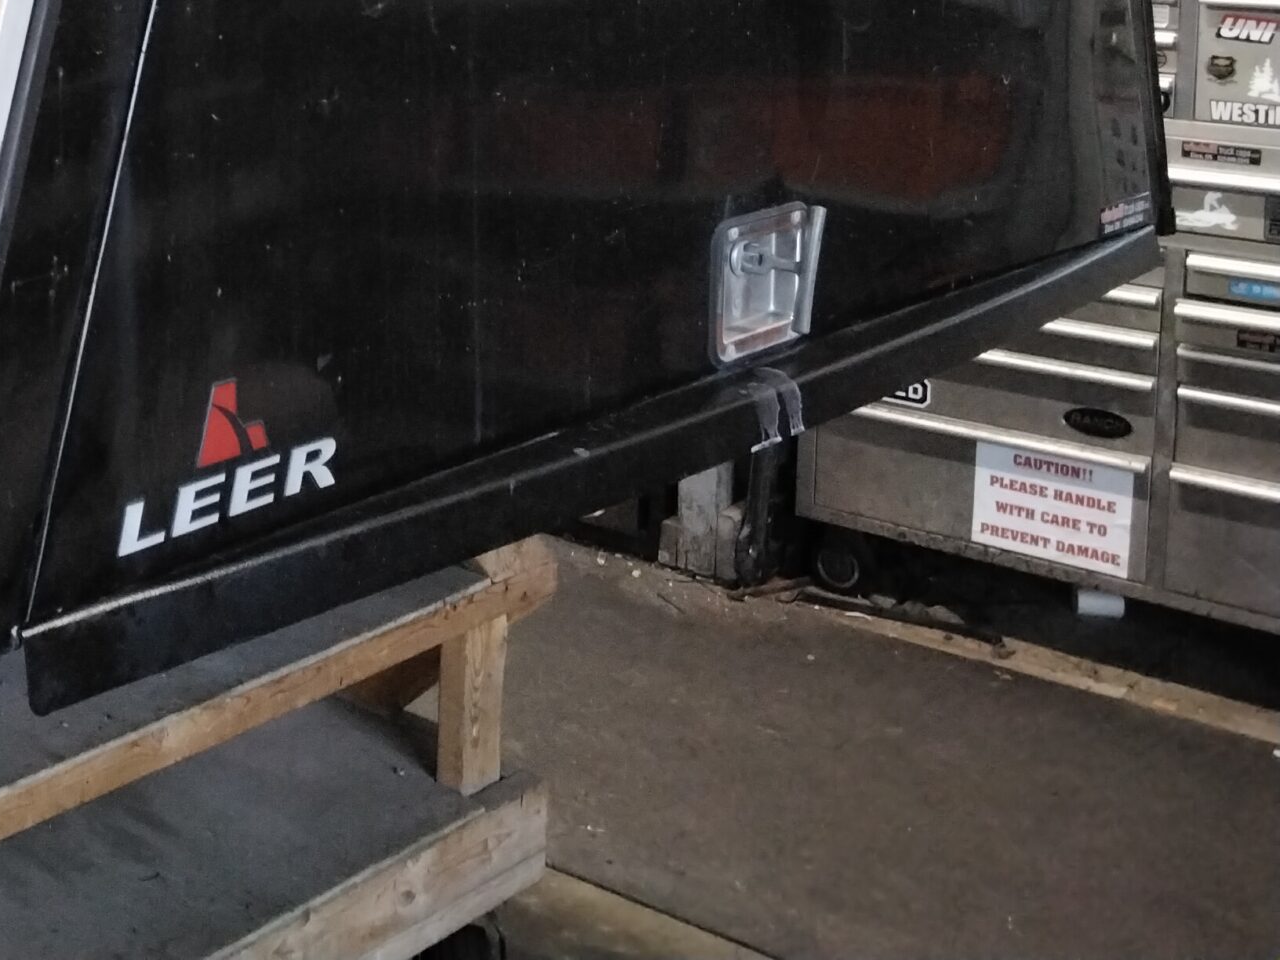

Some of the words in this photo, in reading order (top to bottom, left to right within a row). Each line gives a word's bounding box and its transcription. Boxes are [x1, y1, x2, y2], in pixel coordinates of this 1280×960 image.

[1219, 16, 1278, 43] UNI
[1210, 100, 1280, 126] WESTi
[1013, 453, 1093, 482] CAUTION!!
[118, 437, 336, 558] LEER
[989, 474, 1049, 499] PLEASE
[1053, 488, 1117, 514] HANDLE
[995, 501, 1035, 521] WITH
[1040, 511, 1082, 531] CARE
[1086, 522, 1108, 537] TO
[980, 522, 1051, 549] PREVENT
[1055, 540, 1122, 567] DAMAGE
